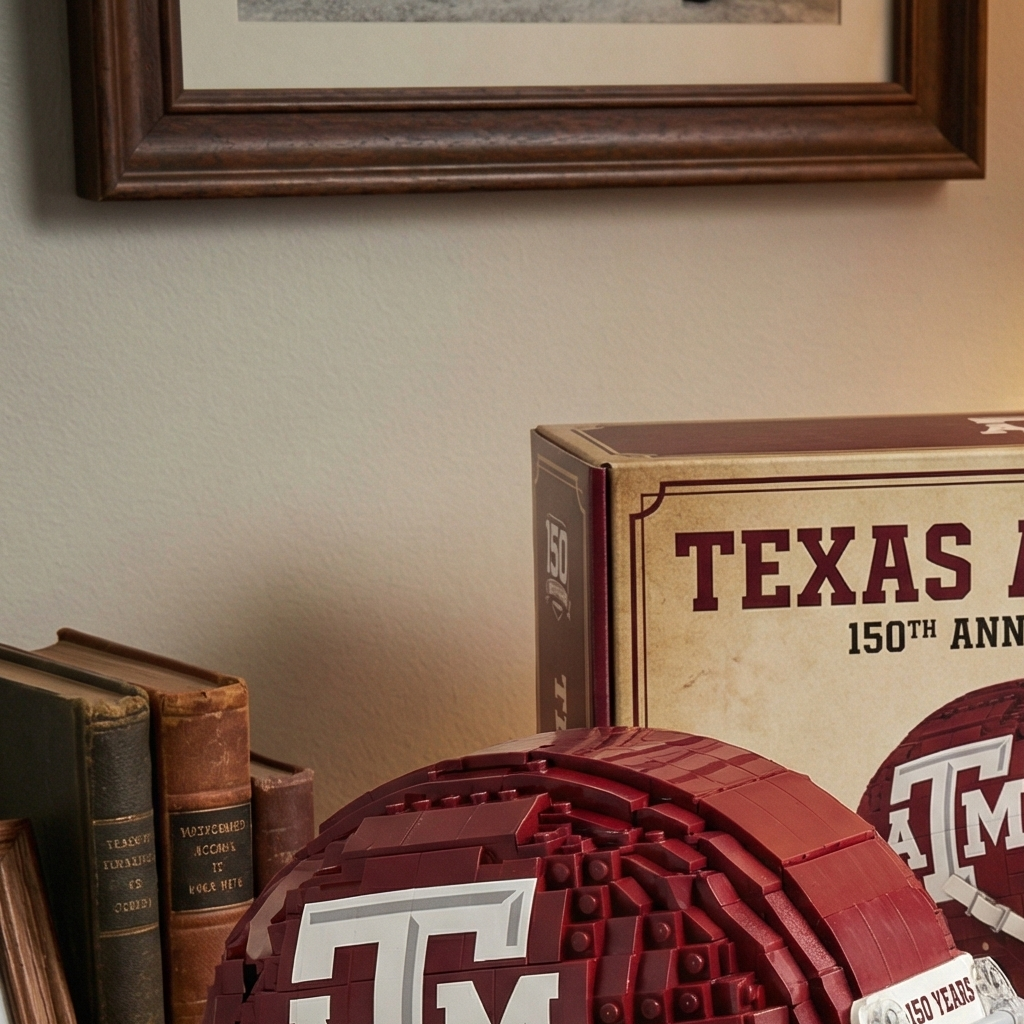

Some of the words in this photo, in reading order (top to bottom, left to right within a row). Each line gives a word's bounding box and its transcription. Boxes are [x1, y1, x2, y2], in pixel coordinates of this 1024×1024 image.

[545, 519, 568, 585] 150
[675, 522, 972, 612] TEXAS
[848, 618, 937, 655] 150TH
[931, 976, 975, 1016] YEARS
